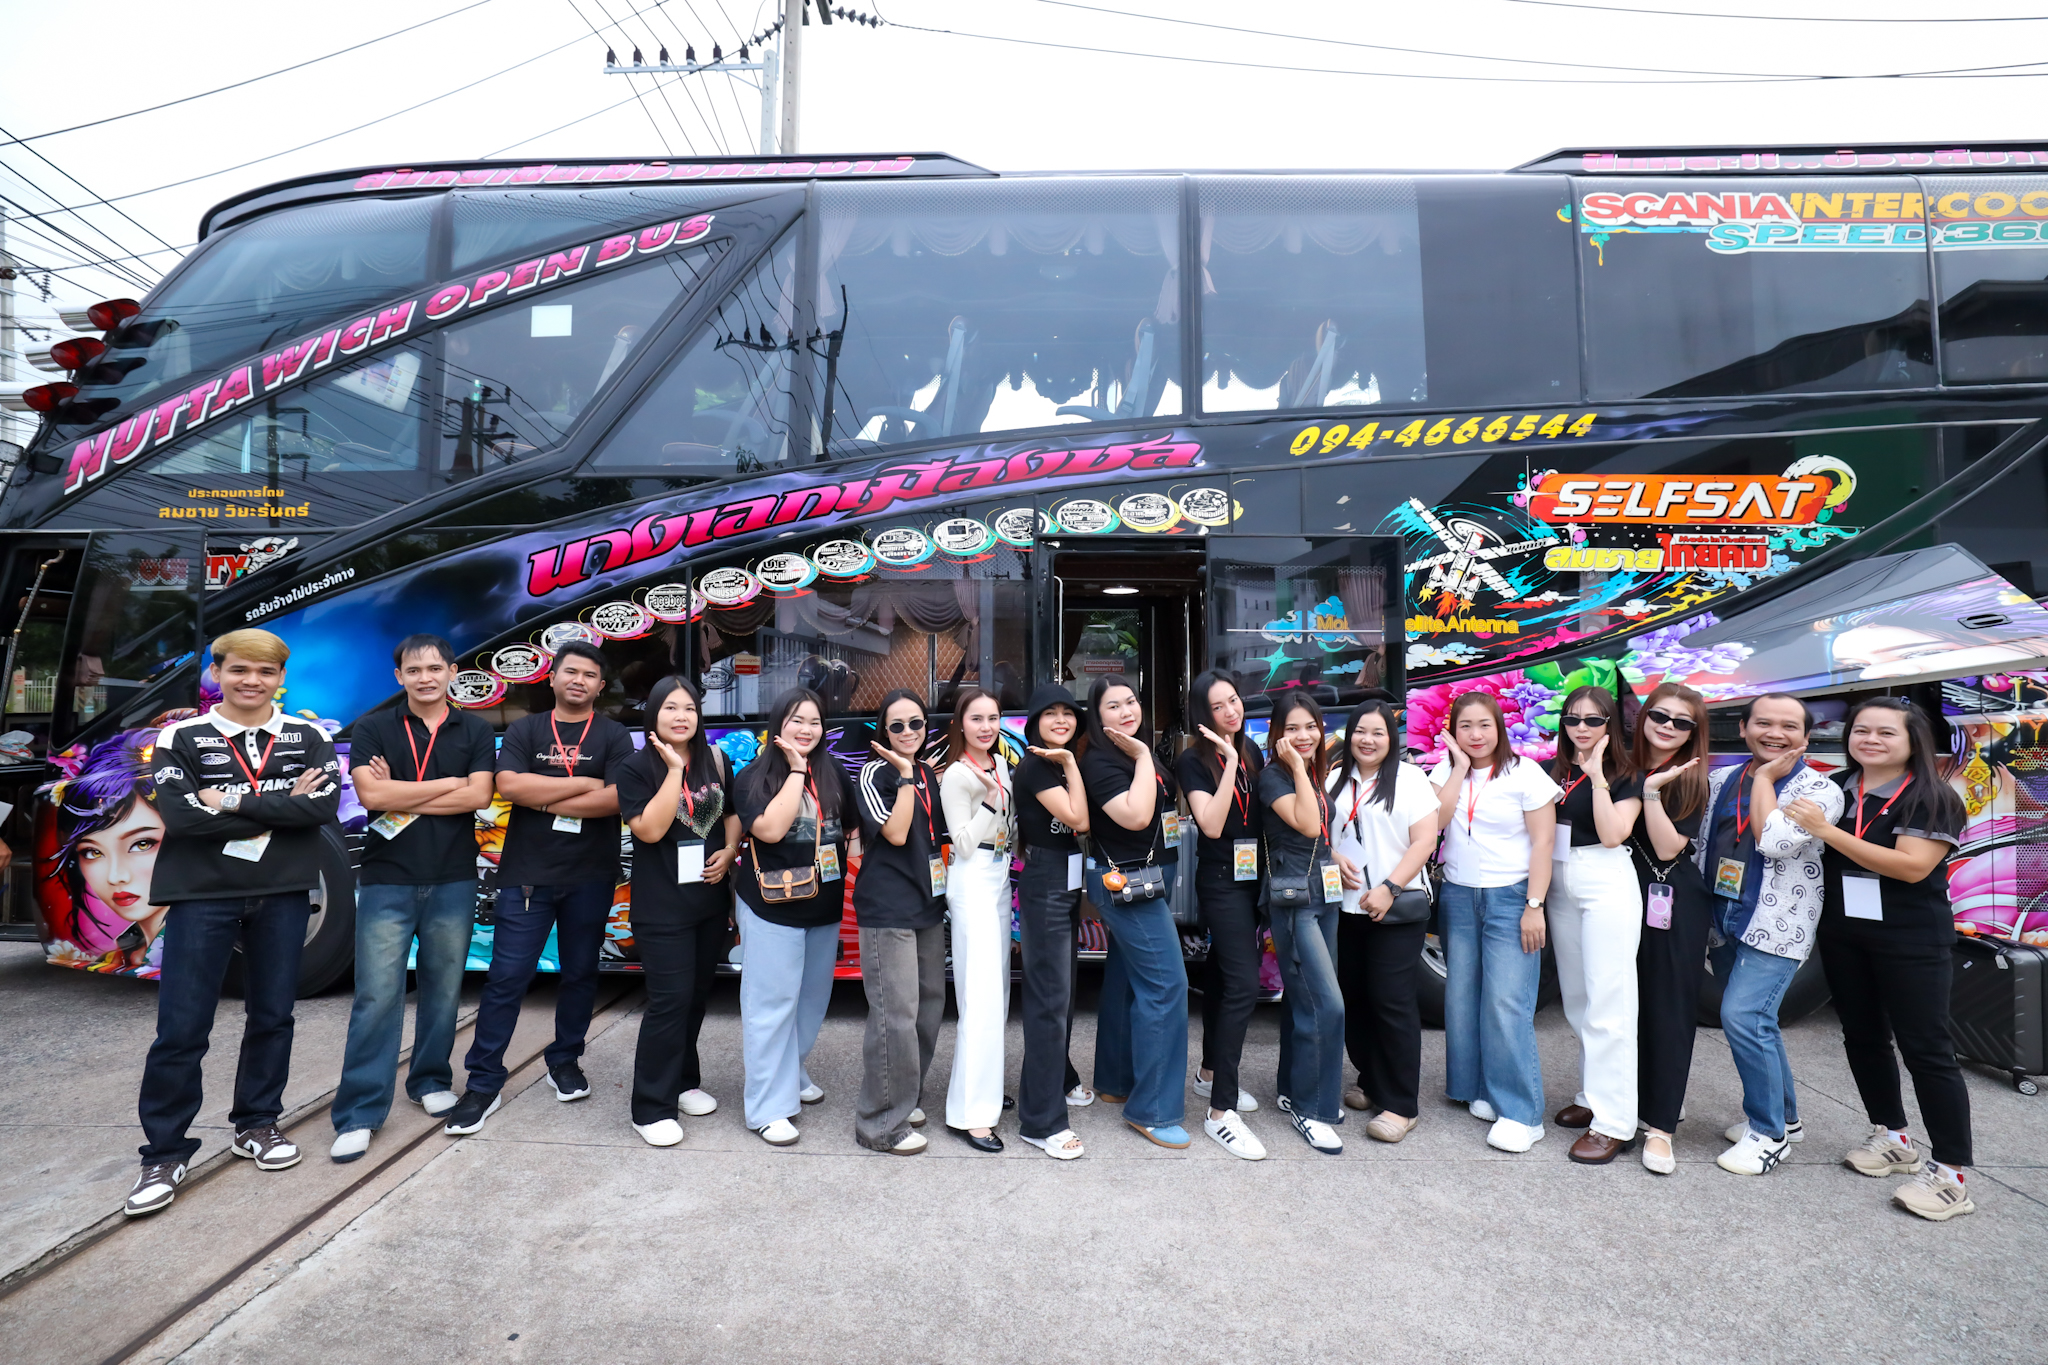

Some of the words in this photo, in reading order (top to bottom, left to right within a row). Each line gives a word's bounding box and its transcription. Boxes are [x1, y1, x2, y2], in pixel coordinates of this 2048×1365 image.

[1582, 192, 1797, 223] SCANIA
[425, 245, 591, 322] OPEN
[595, 213, 718, 267] BUS
[1289, 413, 1598, 457] 094-4666544
[188, 486, 285, 499] ประกอบการโดย
[1551, 481, 1817, 519] SELFSAT
[158, 506, 220, 519] สมชาย
[528, 432, 1202, 598] นางเอกเมืองชล
[1655, 533, 1768, 570] ไทยคม
[1679, 535, 1709, 544] Made
[1719, 535, 1767, 544] Thailand
[245, 566, 356, 622] รถรับจ้างไม่ประจำทาง
